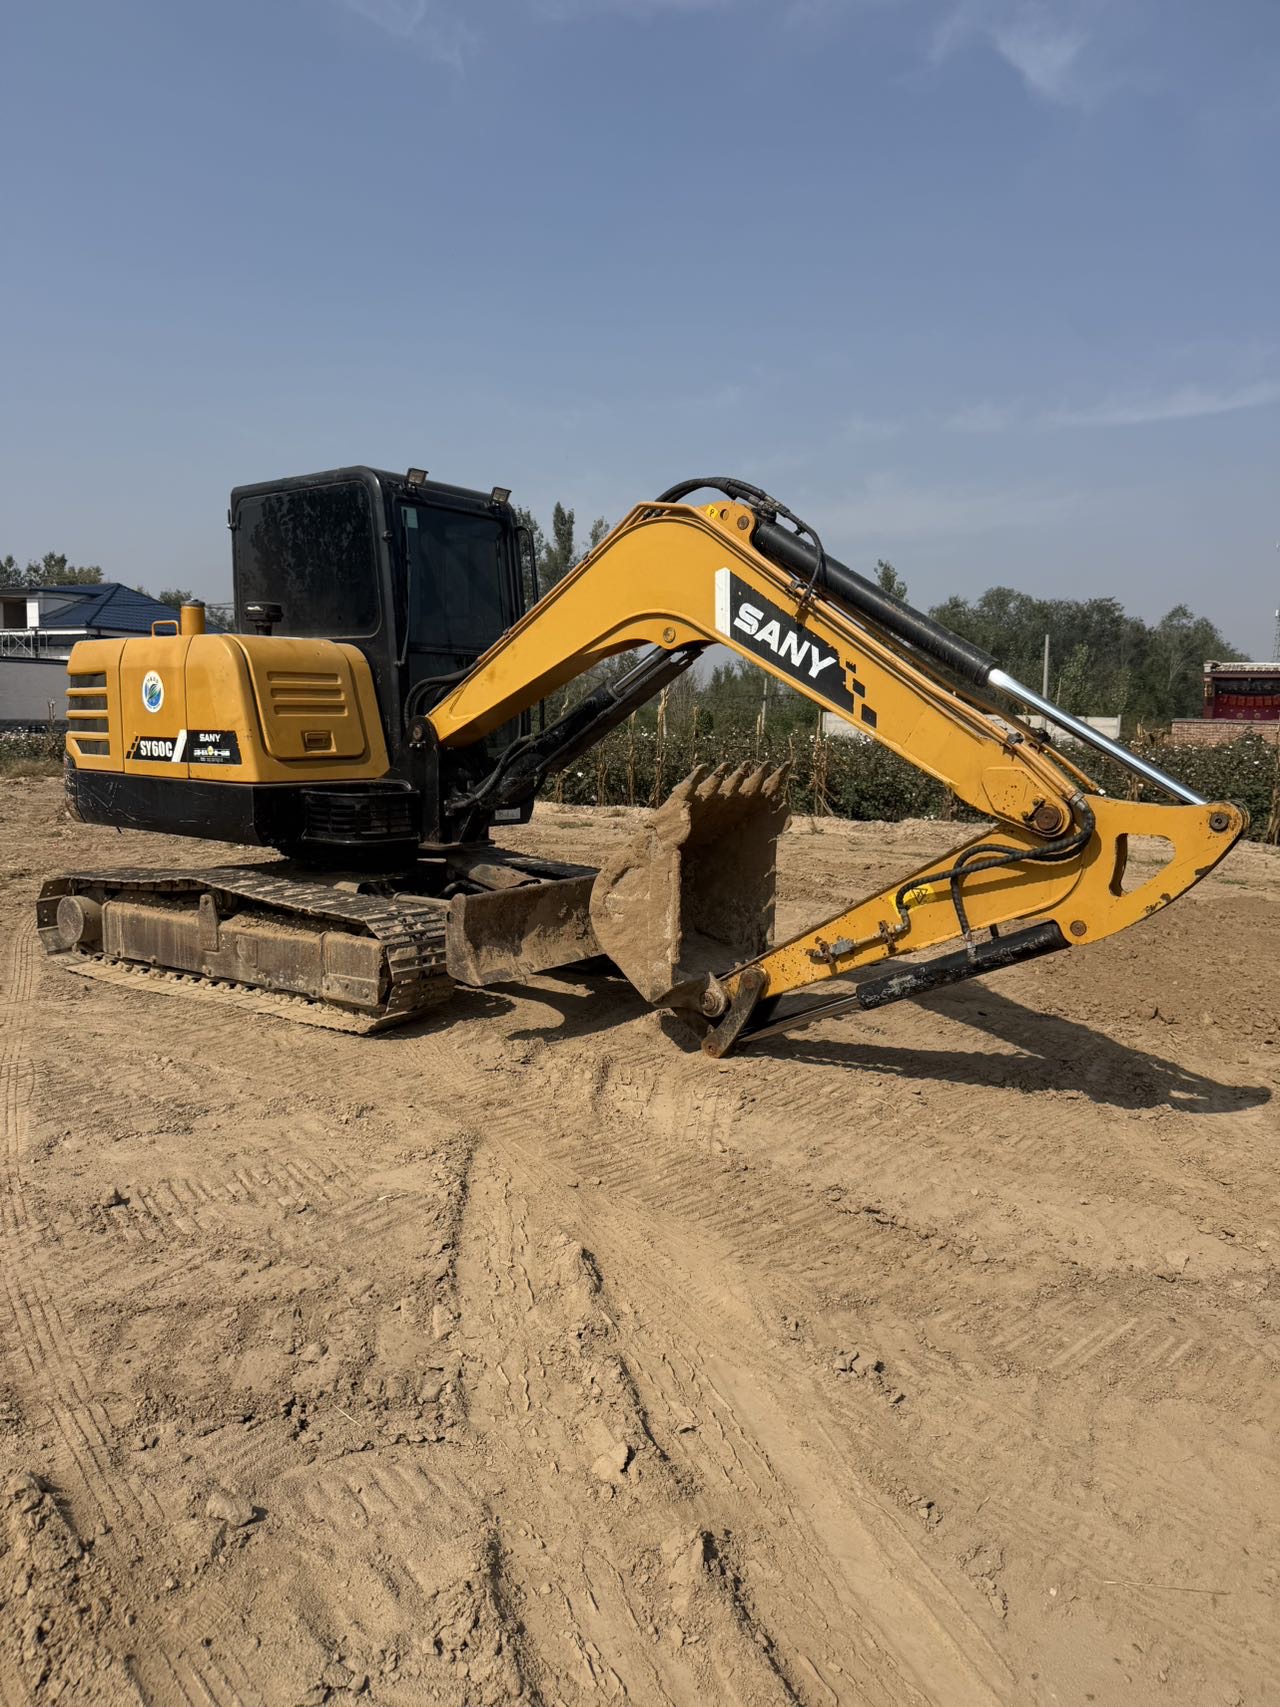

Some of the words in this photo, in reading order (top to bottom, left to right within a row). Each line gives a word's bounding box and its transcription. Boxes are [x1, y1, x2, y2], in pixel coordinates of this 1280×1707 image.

[732, 602, 838, 679] SANY
[199, 733, 221, 742] SANY
[139, 740, 173, 757] SY60C
